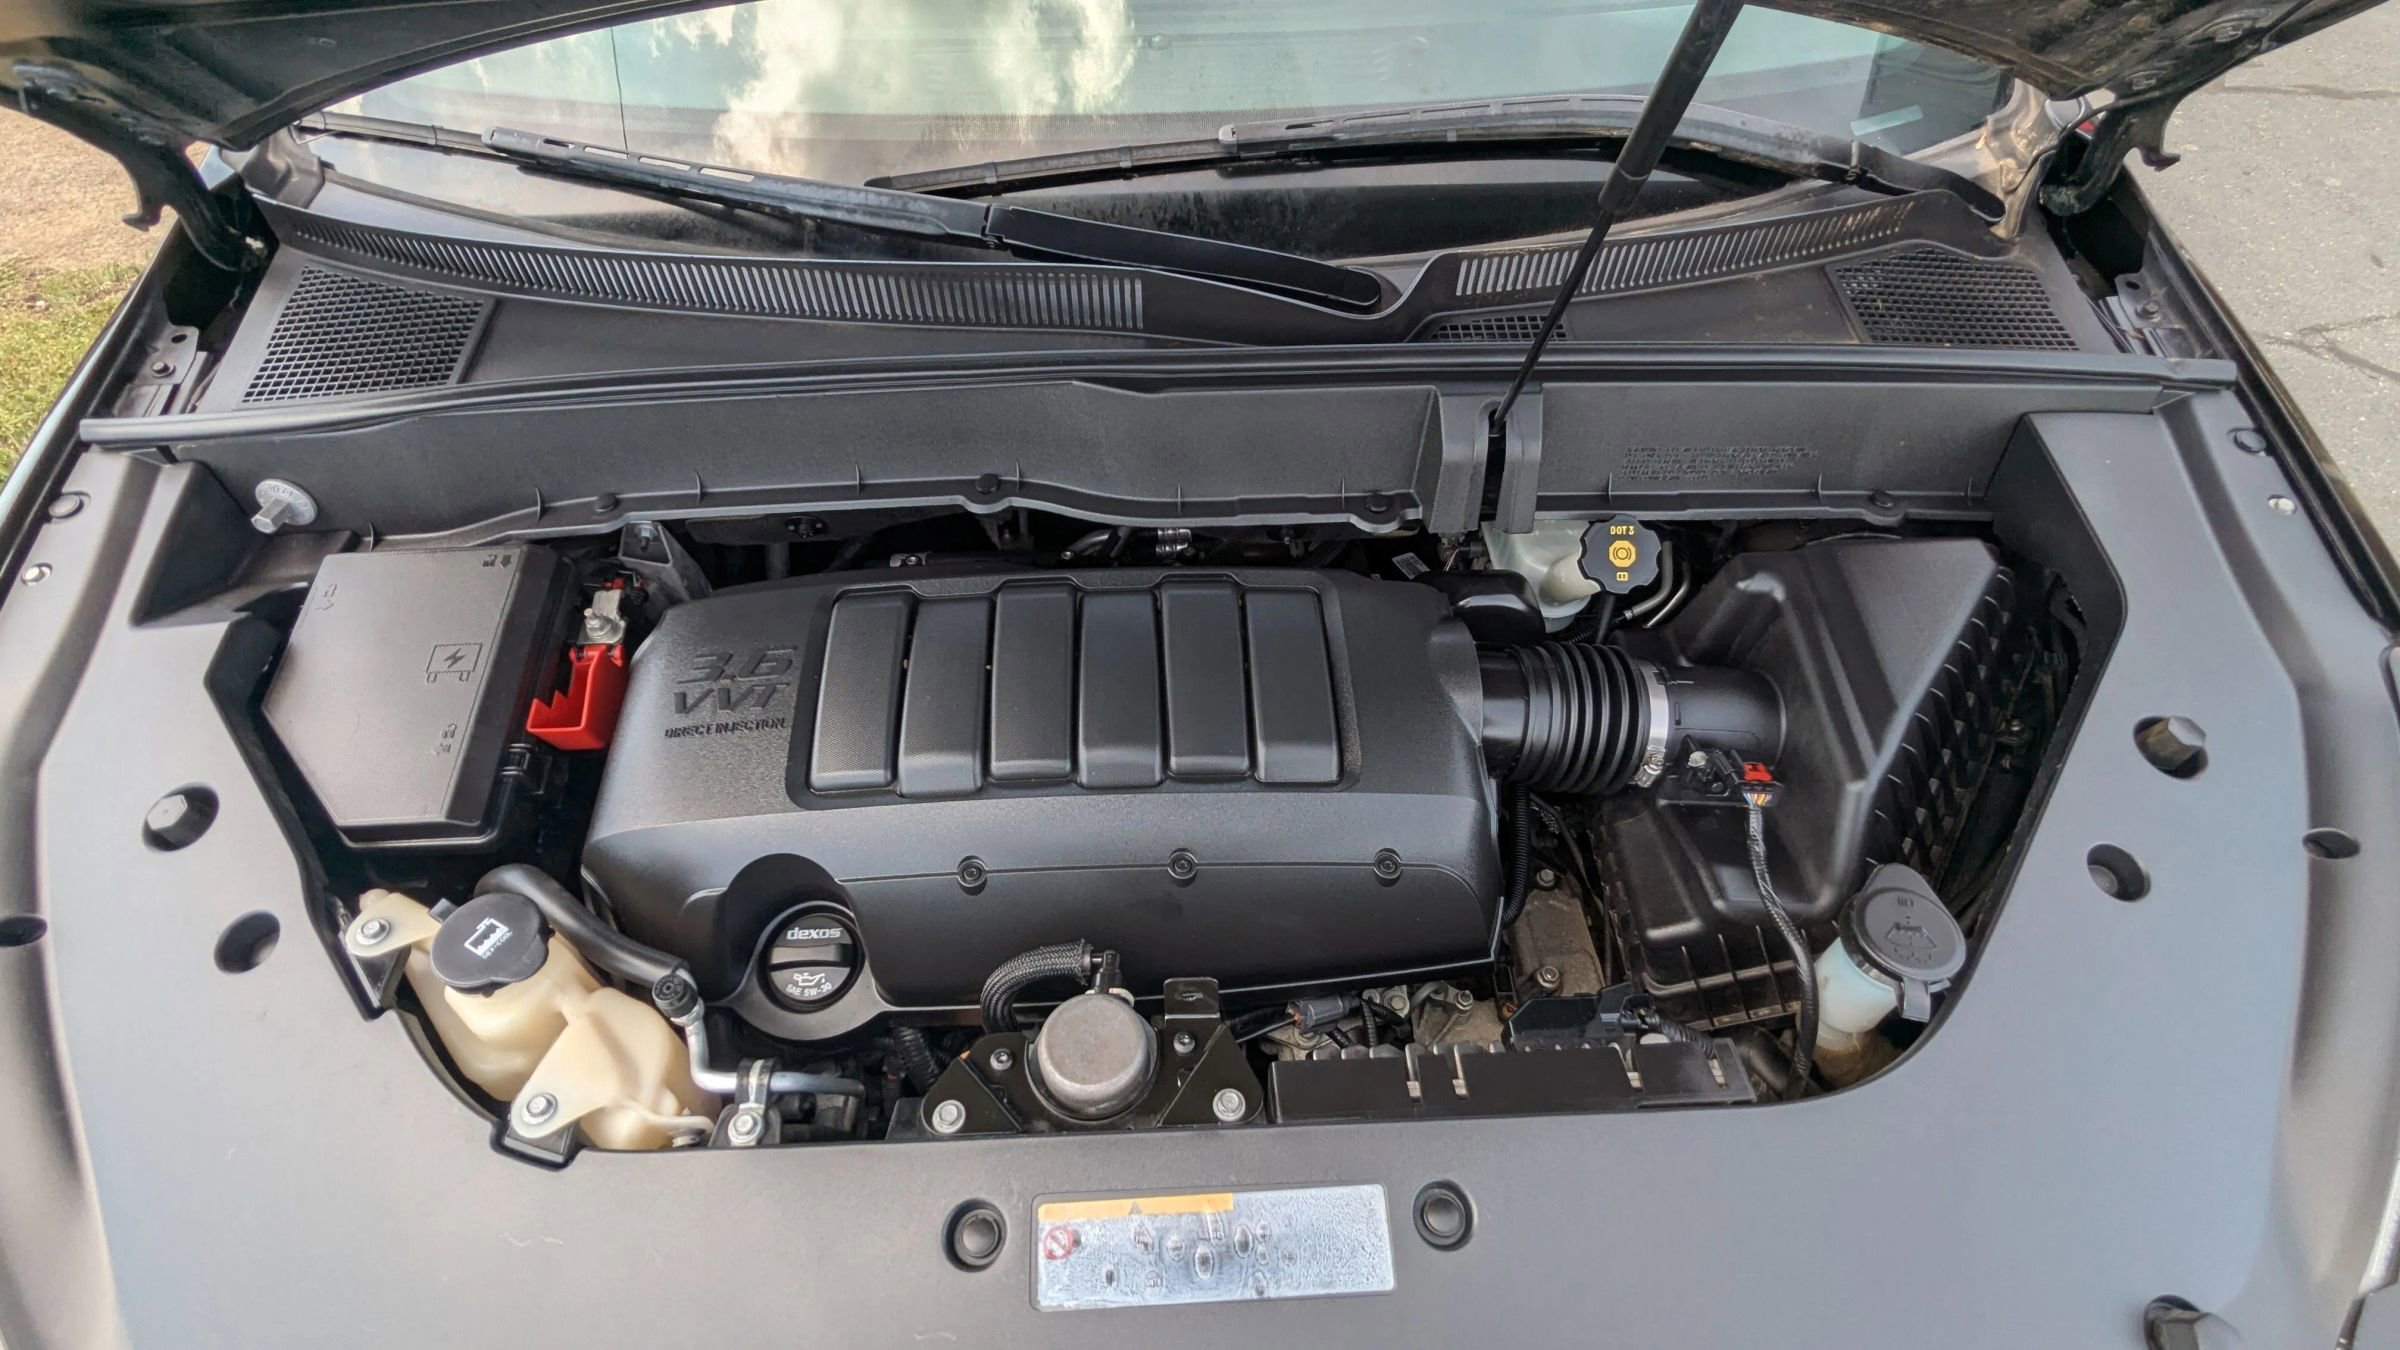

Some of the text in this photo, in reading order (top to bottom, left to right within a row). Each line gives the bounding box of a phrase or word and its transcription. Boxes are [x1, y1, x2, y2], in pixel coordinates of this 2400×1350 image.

[1610, 525, 1635, 536] DOT 3
[676, 645, 798, 685] 3.6
[674, 682, 791, 715] VVT
[664, 717, 785, 739] DIRECT INJECTION
[786, 926, 844, 941] dexos
[785, 982, 833, 997] SAE 5W-30
